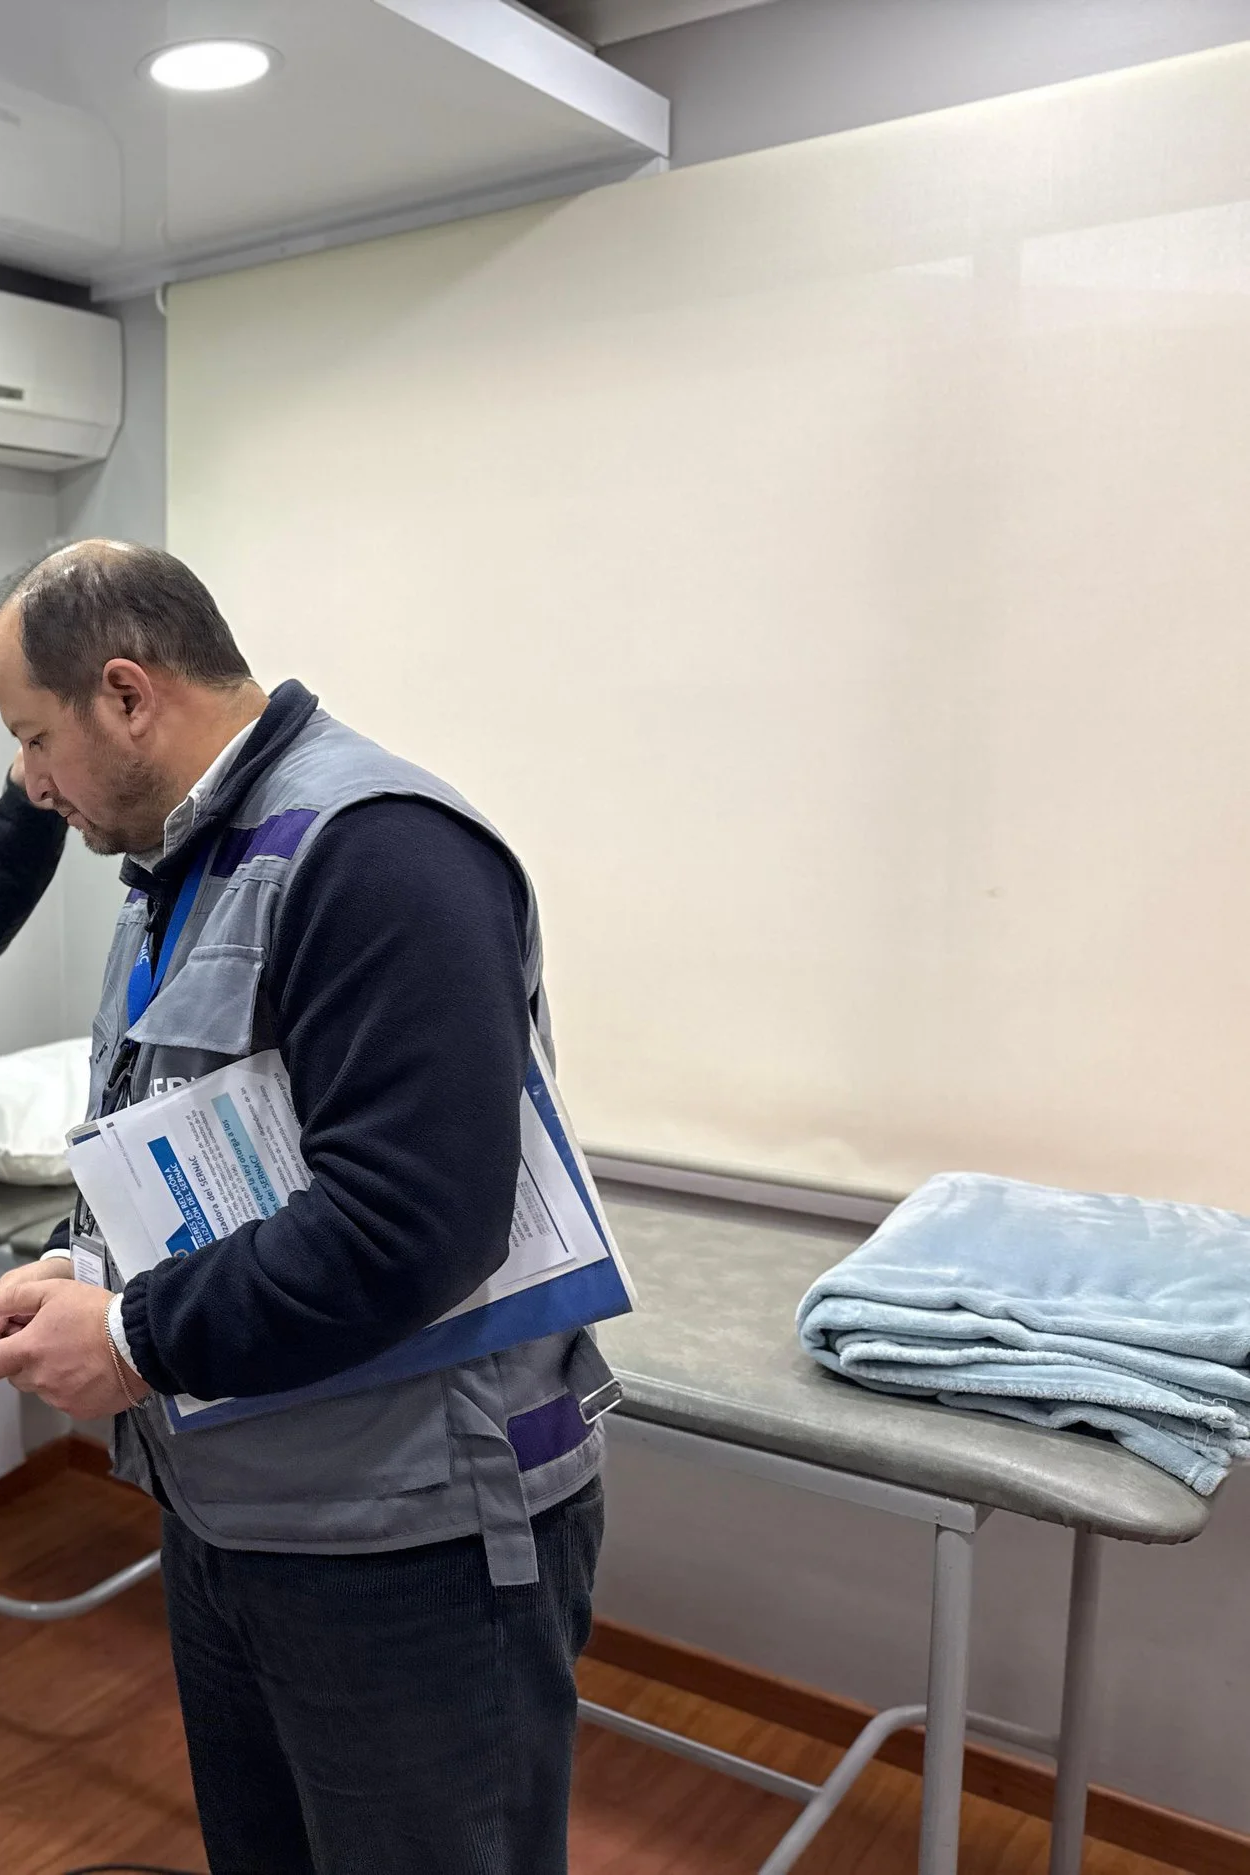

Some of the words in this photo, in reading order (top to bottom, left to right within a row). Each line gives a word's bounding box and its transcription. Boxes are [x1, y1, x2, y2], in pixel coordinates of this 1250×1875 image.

[220, 1118, 231, 1131] los
[229, 1136, 247, 1164] otorga
[169, 1162, 188, 1191] SERNAC
[188, 1154, 208, 1187] SERNAC
[240, 1162, 252, 1177] ley
[247, 1153, 270, 1189] SERNAC?
[165, 1173, 188, 1209] RELACIÓN
[247, 1177, 255, 1185] la
[183, 1190, 195, 1205] DEL
[203, 1187, 215, 1202] del
[251, 1184, 264, 1201] que
[264, 1188, 276, 1203] del
[183, 1209, 193, 1220] EN
[190, 1205, 213, 1244] ALIZACIÓN
[210, 1203, 231, 1236] lizadora
[188, 1220, 206, 1247] EBERES
